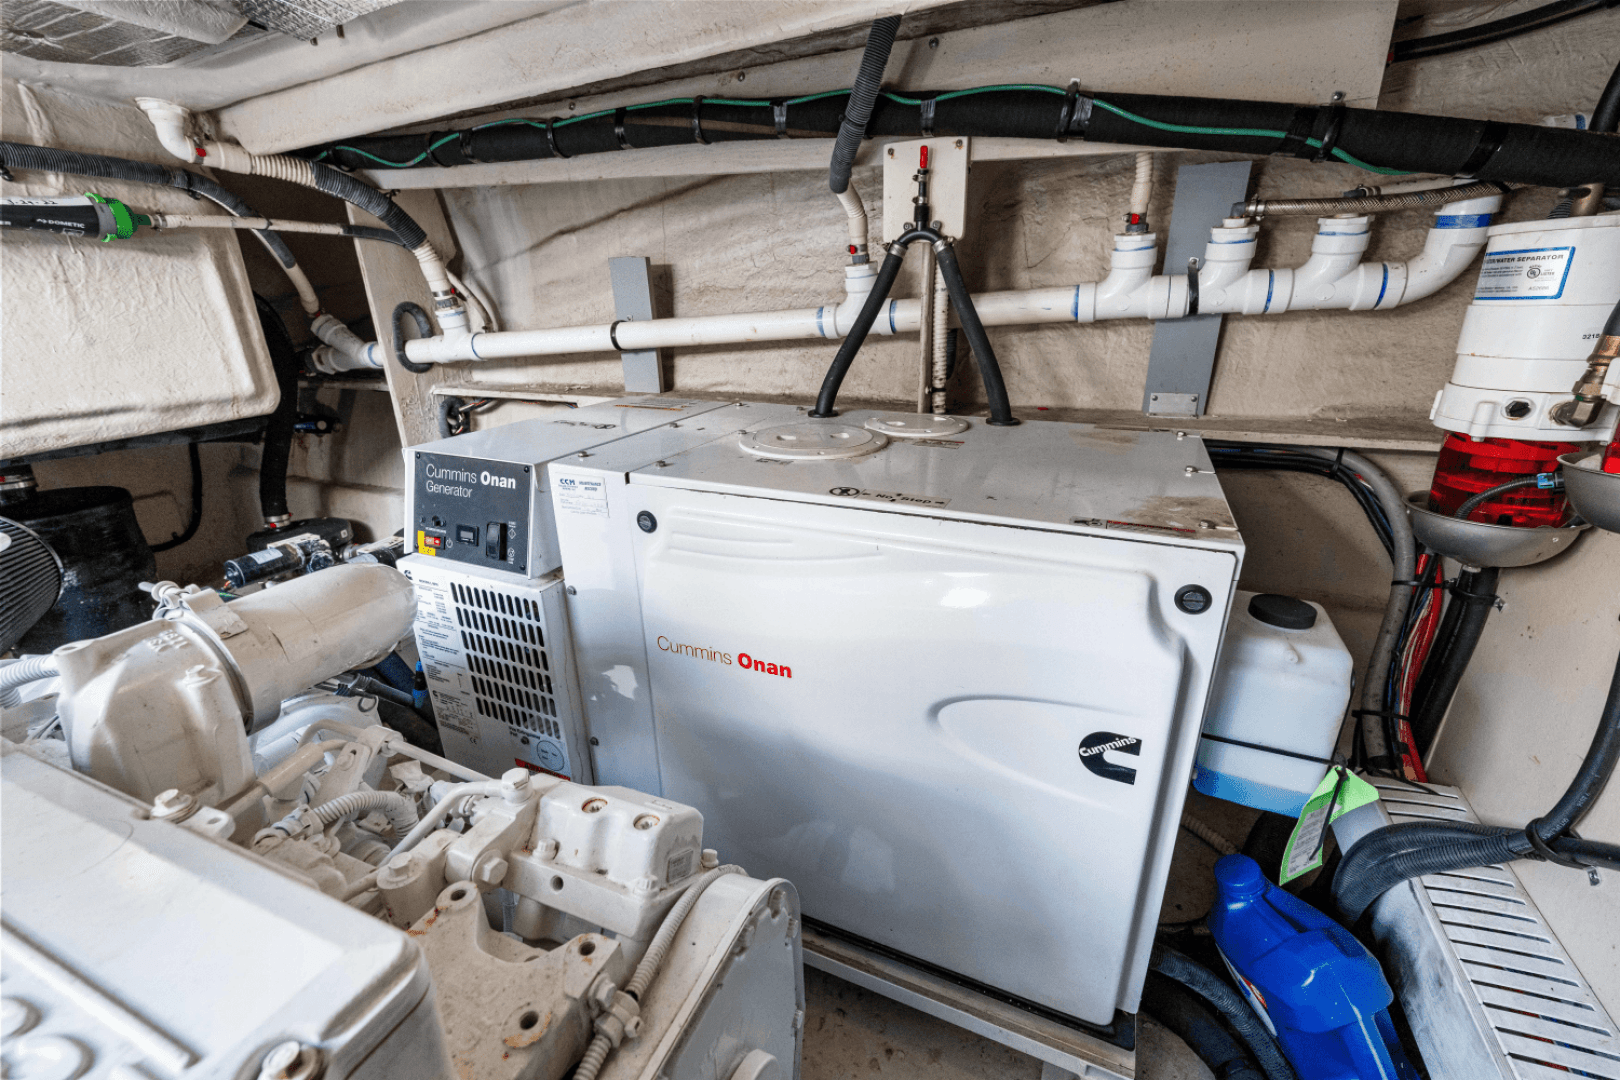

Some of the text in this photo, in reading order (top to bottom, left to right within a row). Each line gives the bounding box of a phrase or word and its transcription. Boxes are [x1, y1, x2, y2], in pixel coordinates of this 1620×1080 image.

[48, 219, 86, 229] DOMETIC
[1517, 254, 1564, 263] SEPARATOR
[425, 463, 516, 489] Cummins Onan
[425, 480, 473, 498] Generator
[657, 635, 793, 679] Cummins Onan
[1079, 737, 1137, 757] Cummins
